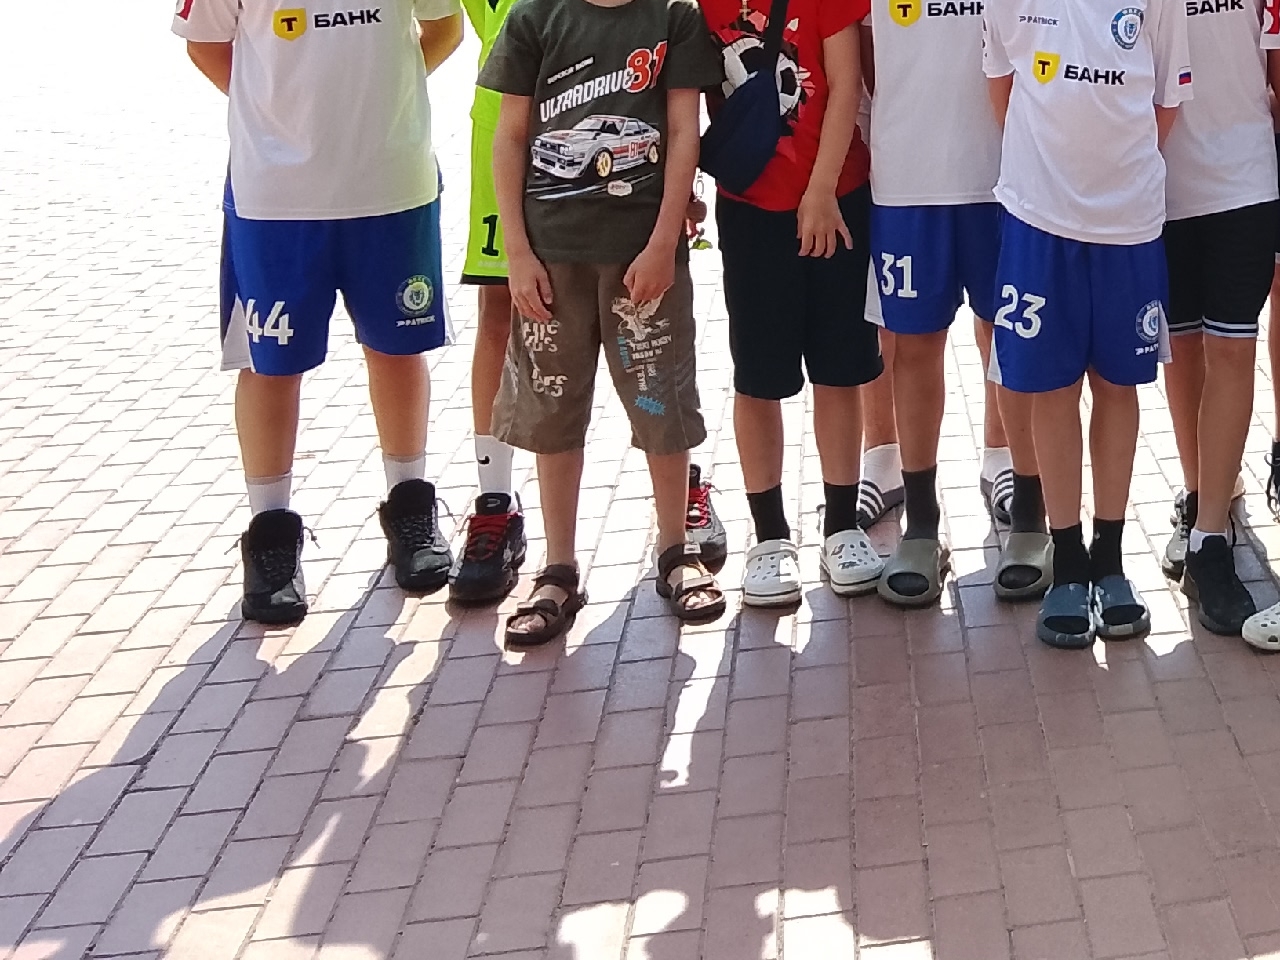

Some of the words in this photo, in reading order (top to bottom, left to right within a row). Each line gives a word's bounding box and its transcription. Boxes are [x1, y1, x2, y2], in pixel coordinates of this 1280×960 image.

[314, 8, 382, 29] БАНК
[626, 40, 668, 93] 81
[1064, 64, 1126, 86] БАНК
[881, 252, 918, 298] 31
[246, 298, 294, 345] 44
[995, 284, 1047, 339] 23
